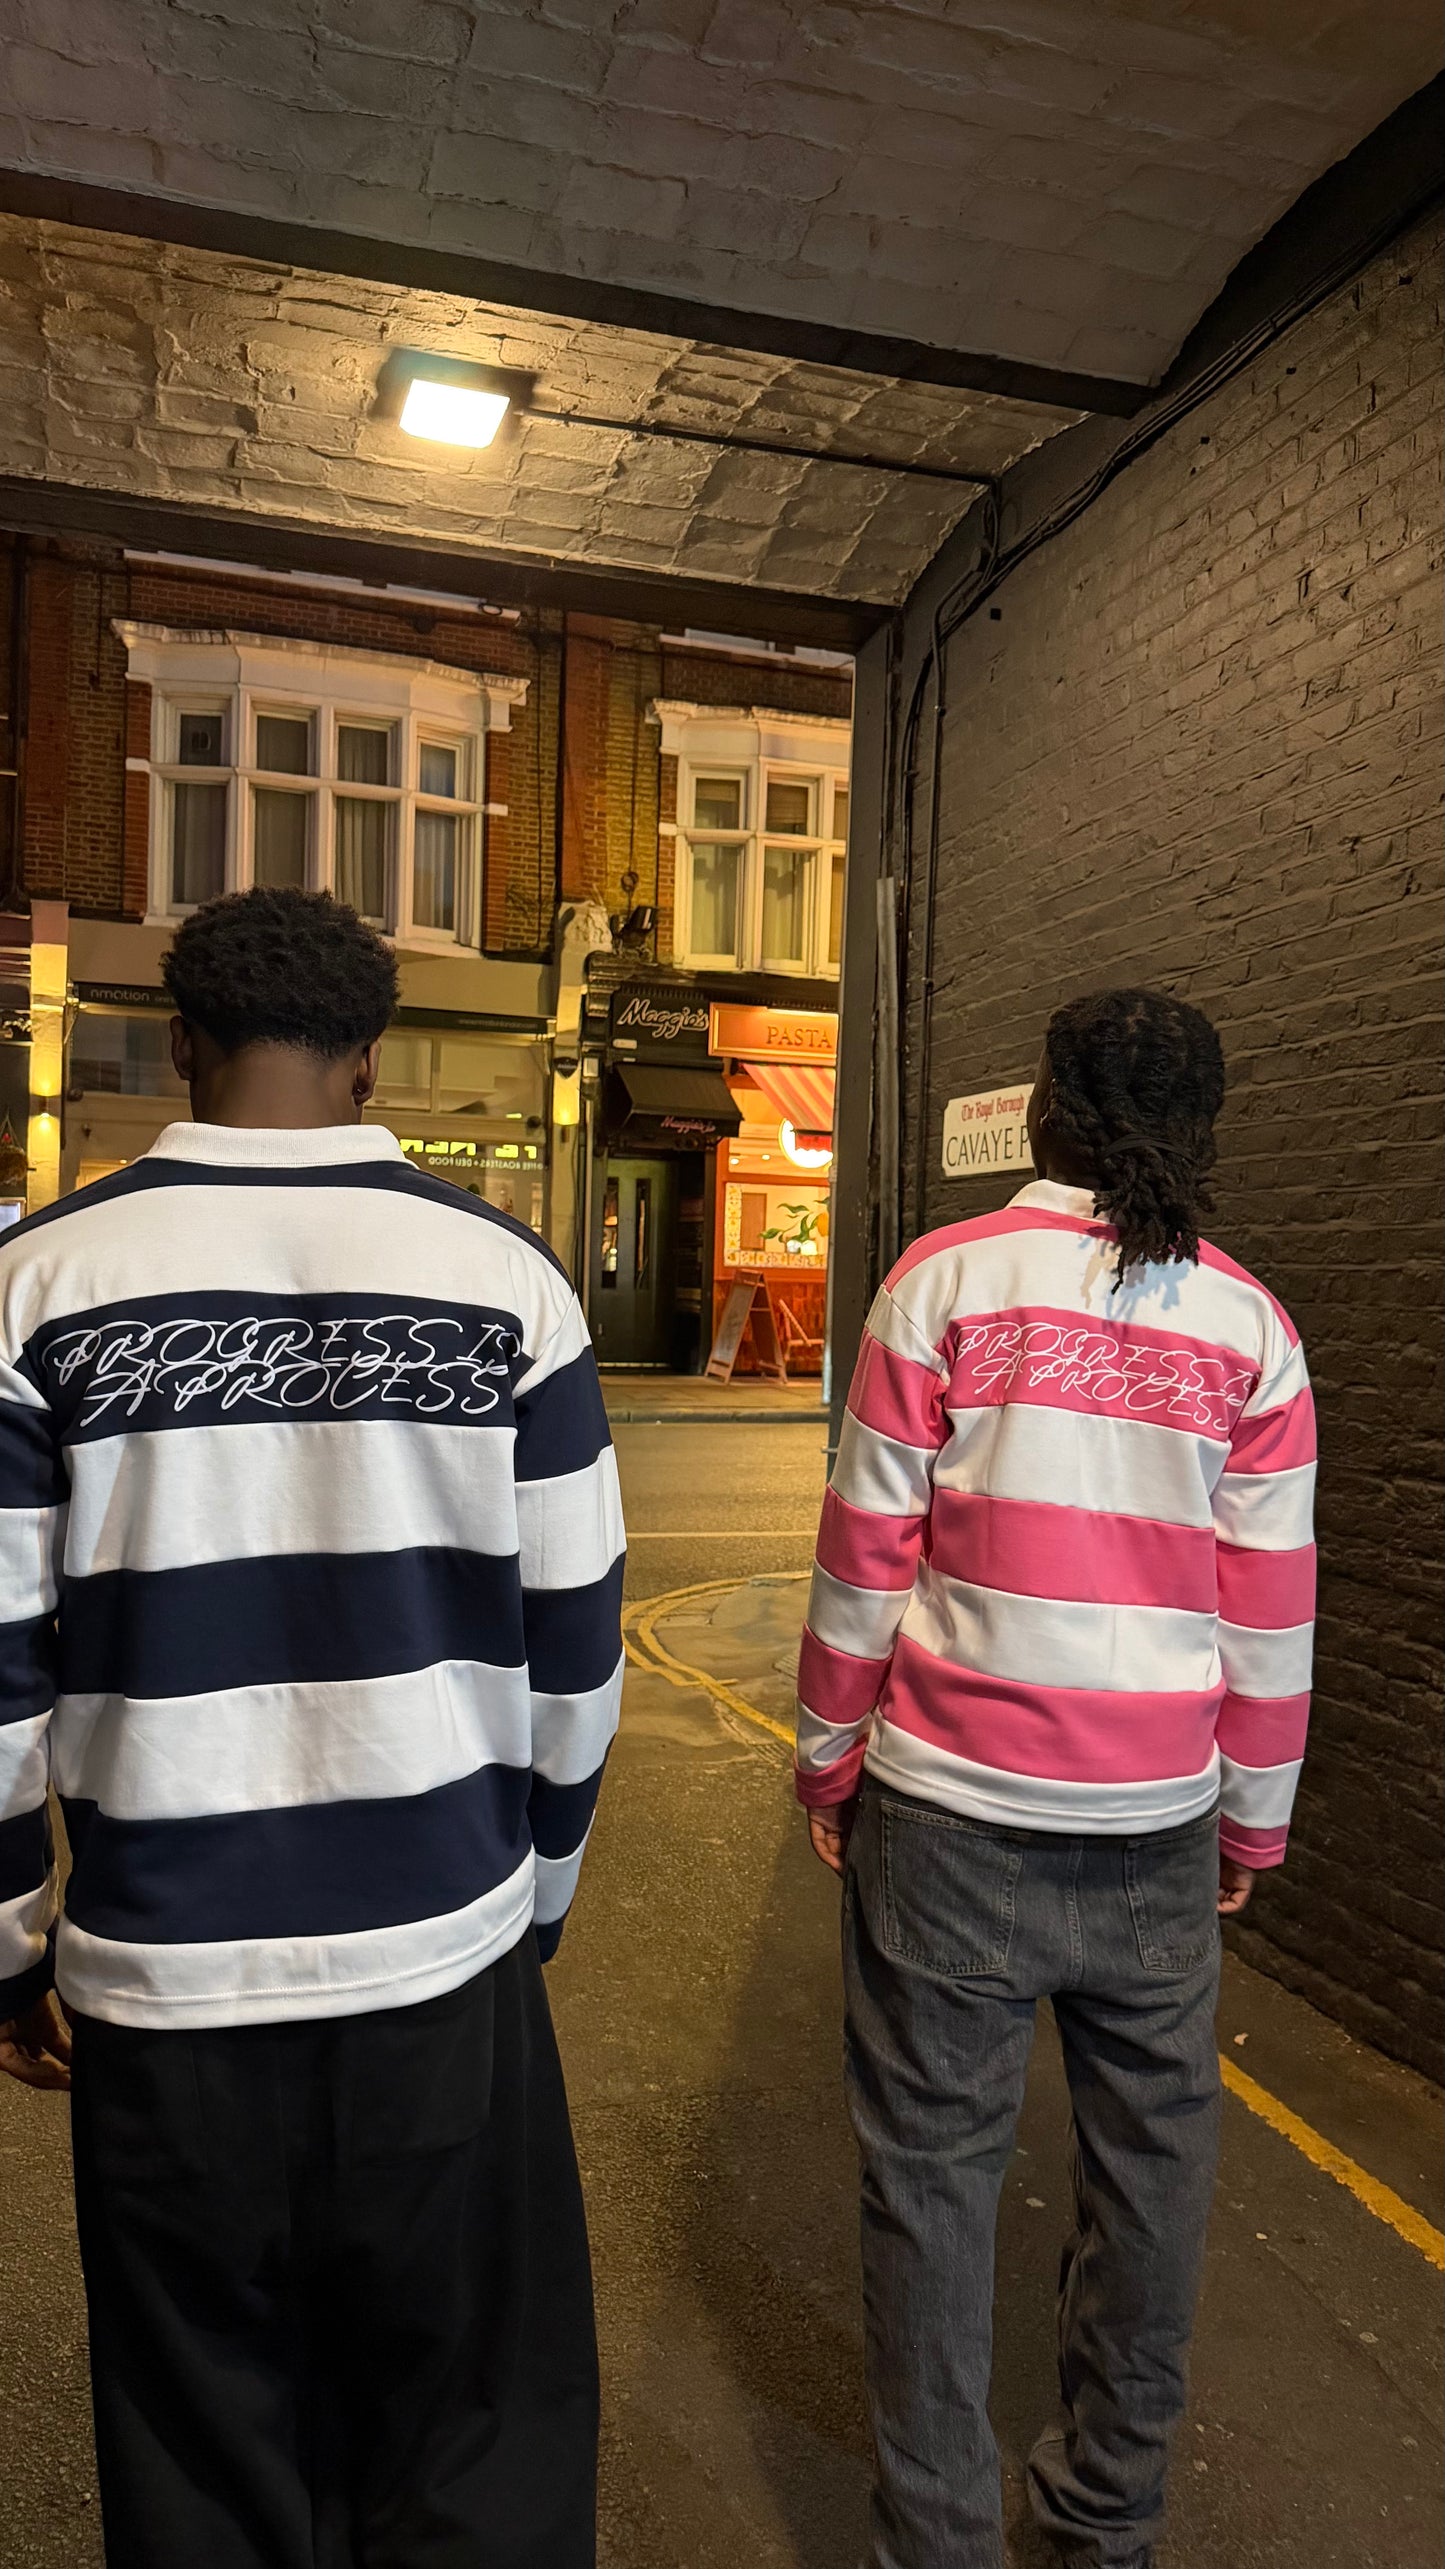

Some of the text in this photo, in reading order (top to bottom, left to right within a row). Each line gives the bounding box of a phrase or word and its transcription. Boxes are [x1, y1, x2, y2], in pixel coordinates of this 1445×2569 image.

[766, 1026, 833, 1049] PASTA
[997, 1094, 1024, 1116] Borough
[946, 1127, 1013, 1167] CAVAYE
[42, 1315, 463, 1386] PROGRESS
[954, 1322, 1224, 1392] PROGRESS
[971, 1348, 1022, 1395] A
[80, 1358, 500, 1427] A PROCESS
